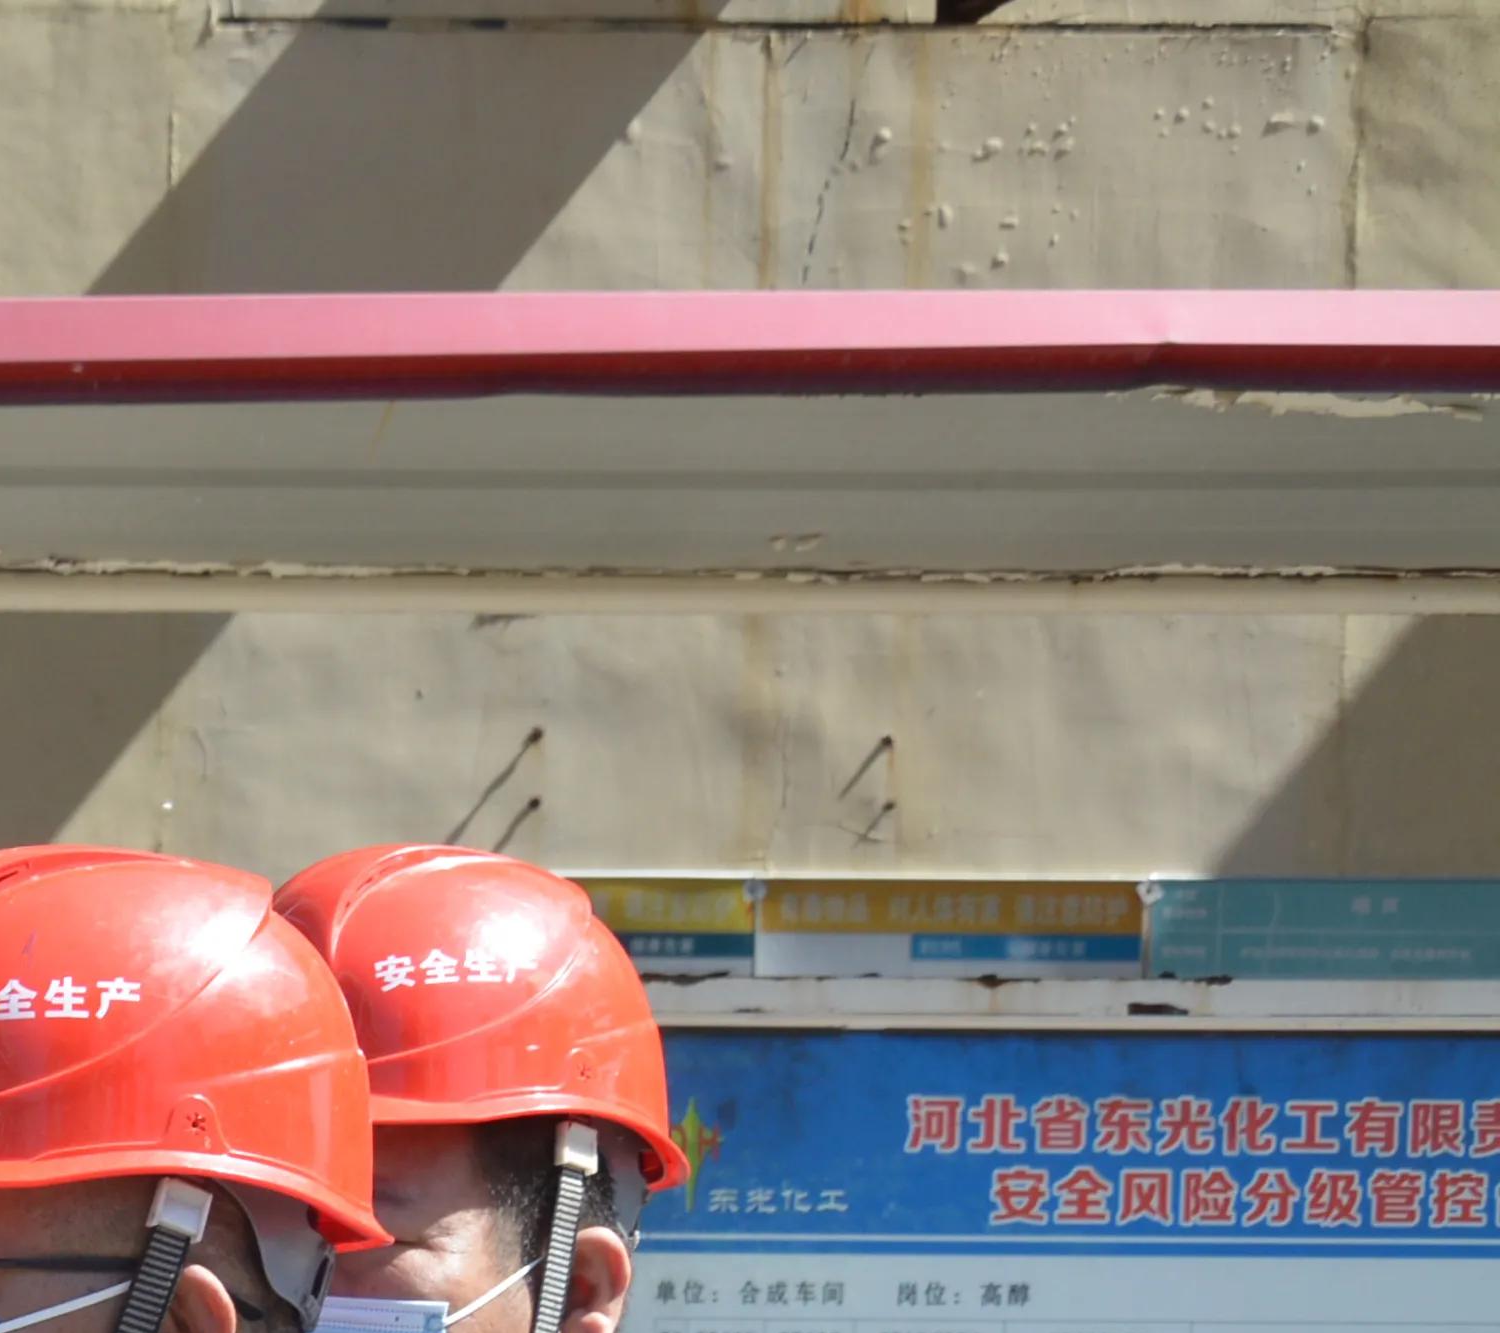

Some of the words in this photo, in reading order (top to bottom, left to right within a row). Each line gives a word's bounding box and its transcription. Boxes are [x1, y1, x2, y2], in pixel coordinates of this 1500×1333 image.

[373, 947, 540, 993] 安全生产
[707, 1186, 850, 1214] 东光化工
[989, 1165, 1500, 1229] 安全风险分级管控
